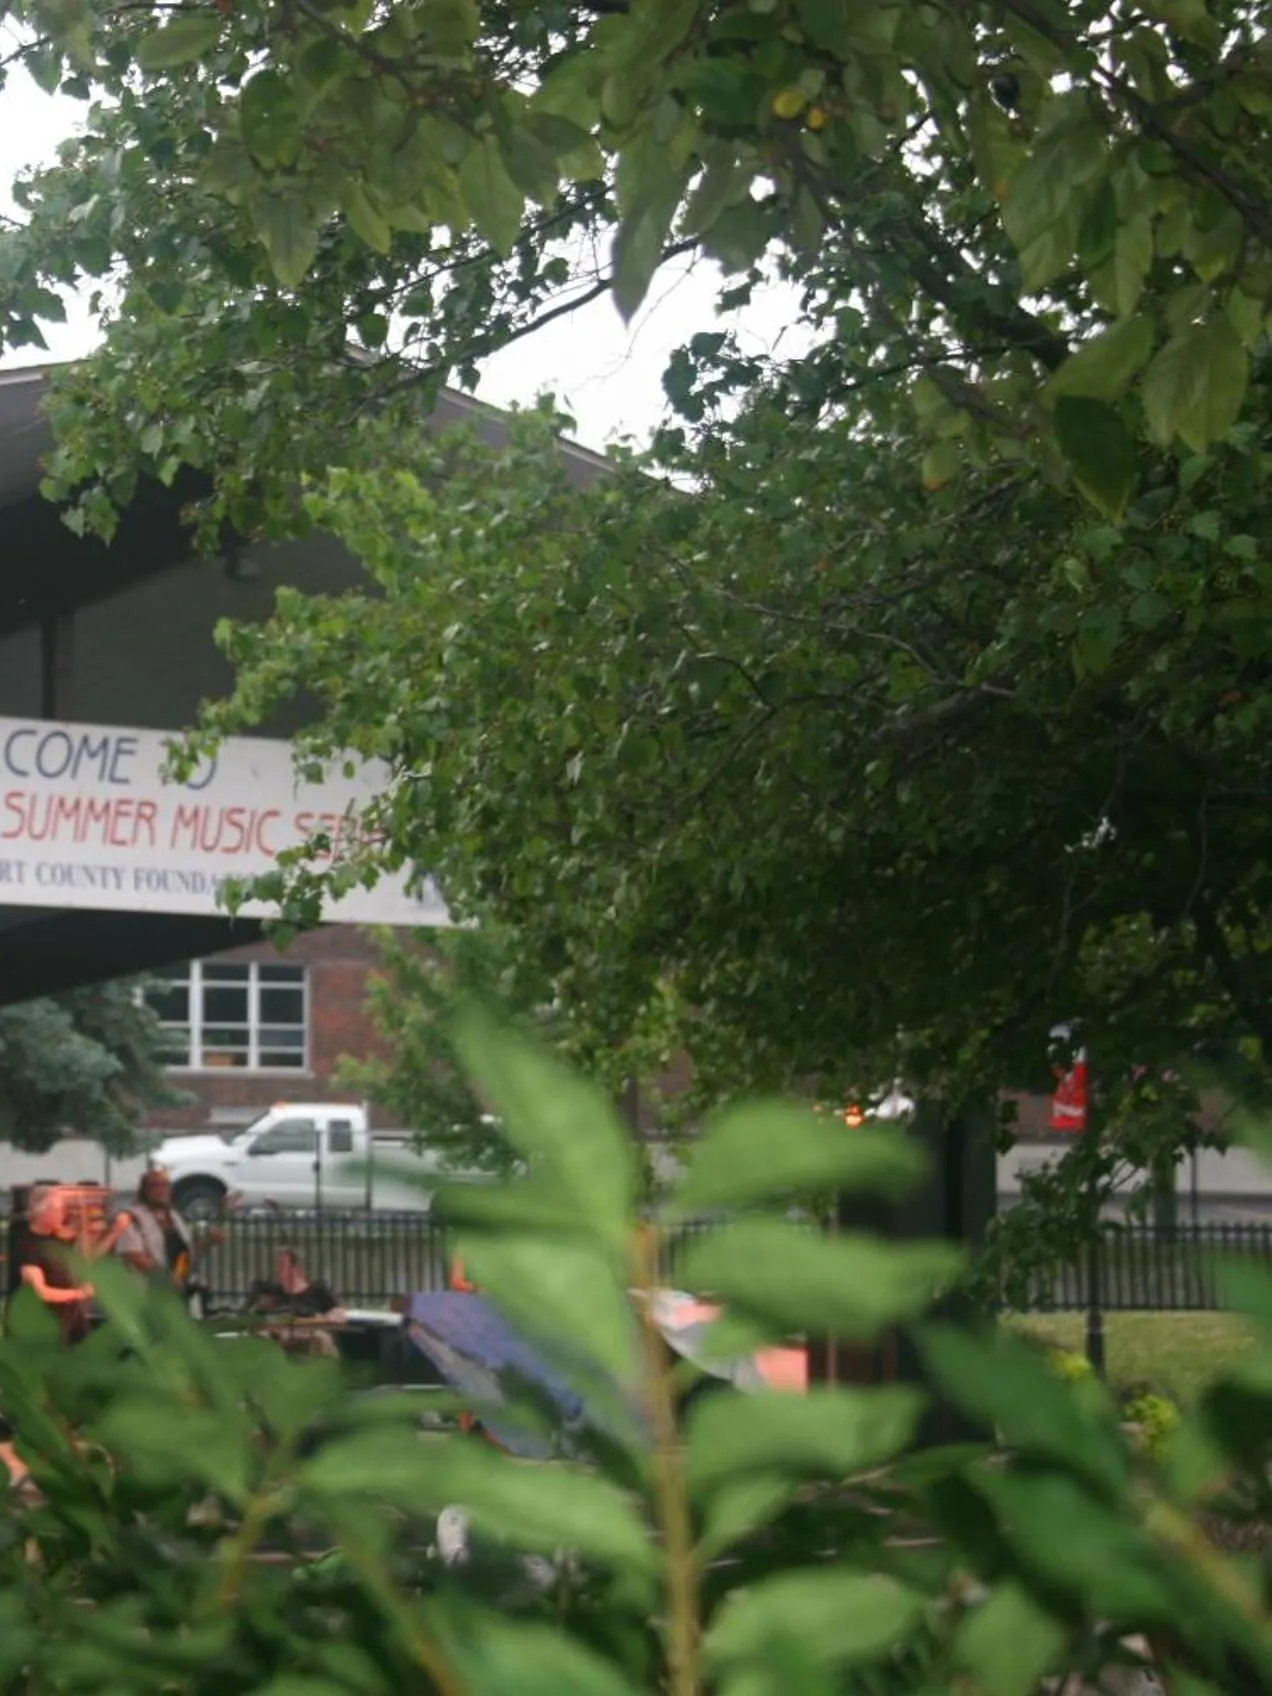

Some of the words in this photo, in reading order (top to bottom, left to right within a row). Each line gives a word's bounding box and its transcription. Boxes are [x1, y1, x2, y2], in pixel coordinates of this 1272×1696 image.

[0, 791, 158, 848] SUMMER
[170, 804, 281, 857] MUSIC
[35, 861, 126, 890] COUNTY
[133, 867, 230, 895] FOUND
